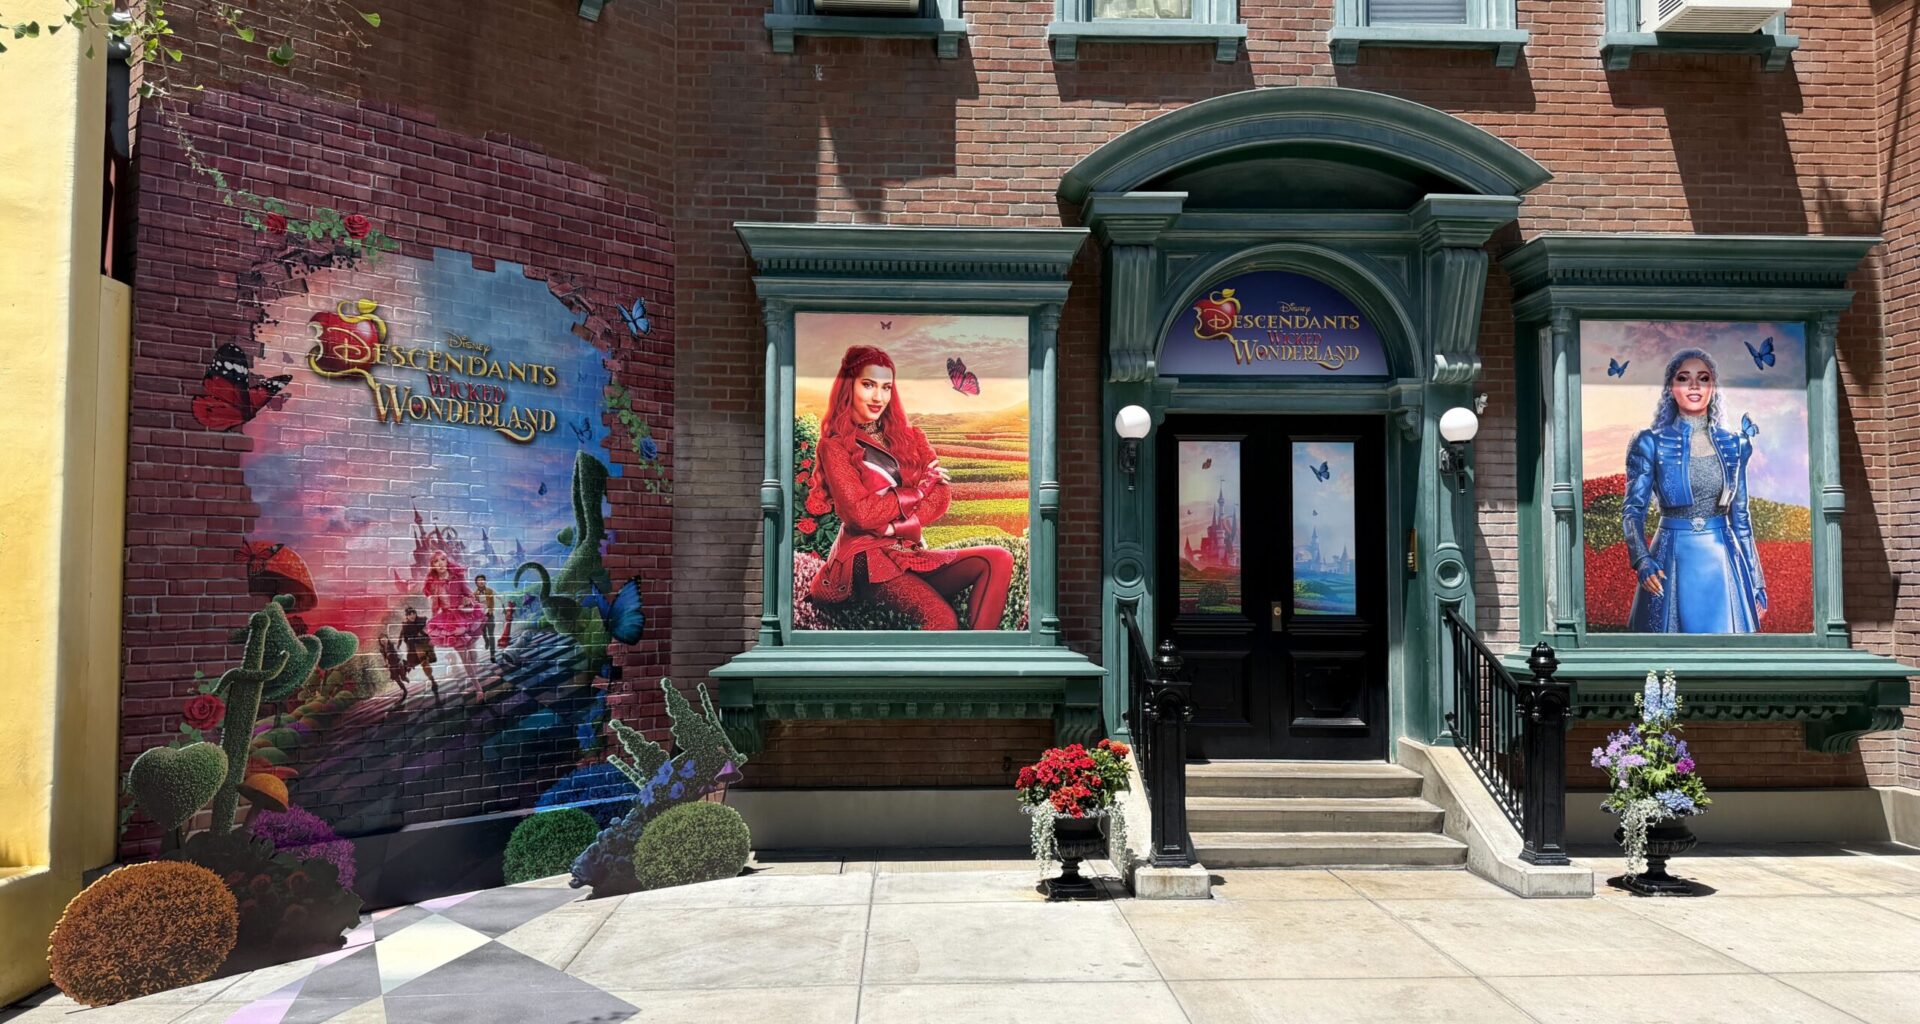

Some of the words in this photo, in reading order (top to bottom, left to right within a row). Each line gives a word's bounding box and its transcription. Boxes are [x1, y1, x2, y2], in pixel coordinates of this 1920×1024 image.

[1203, 308, 1360, 330] DESCENDANTS
[1278, 301, 1312, 315] Disney
[446, 331, 491, 356] Disney
[1267, 330, 1323, 345] WICKED
[327, 327, 558, 387] DESCENDANTS
[1232, 339, 1360, 370] WONDERLAND
[427, 373, 506, 404] WICKED
[374, 382, 556, 442] WONDERLAND
